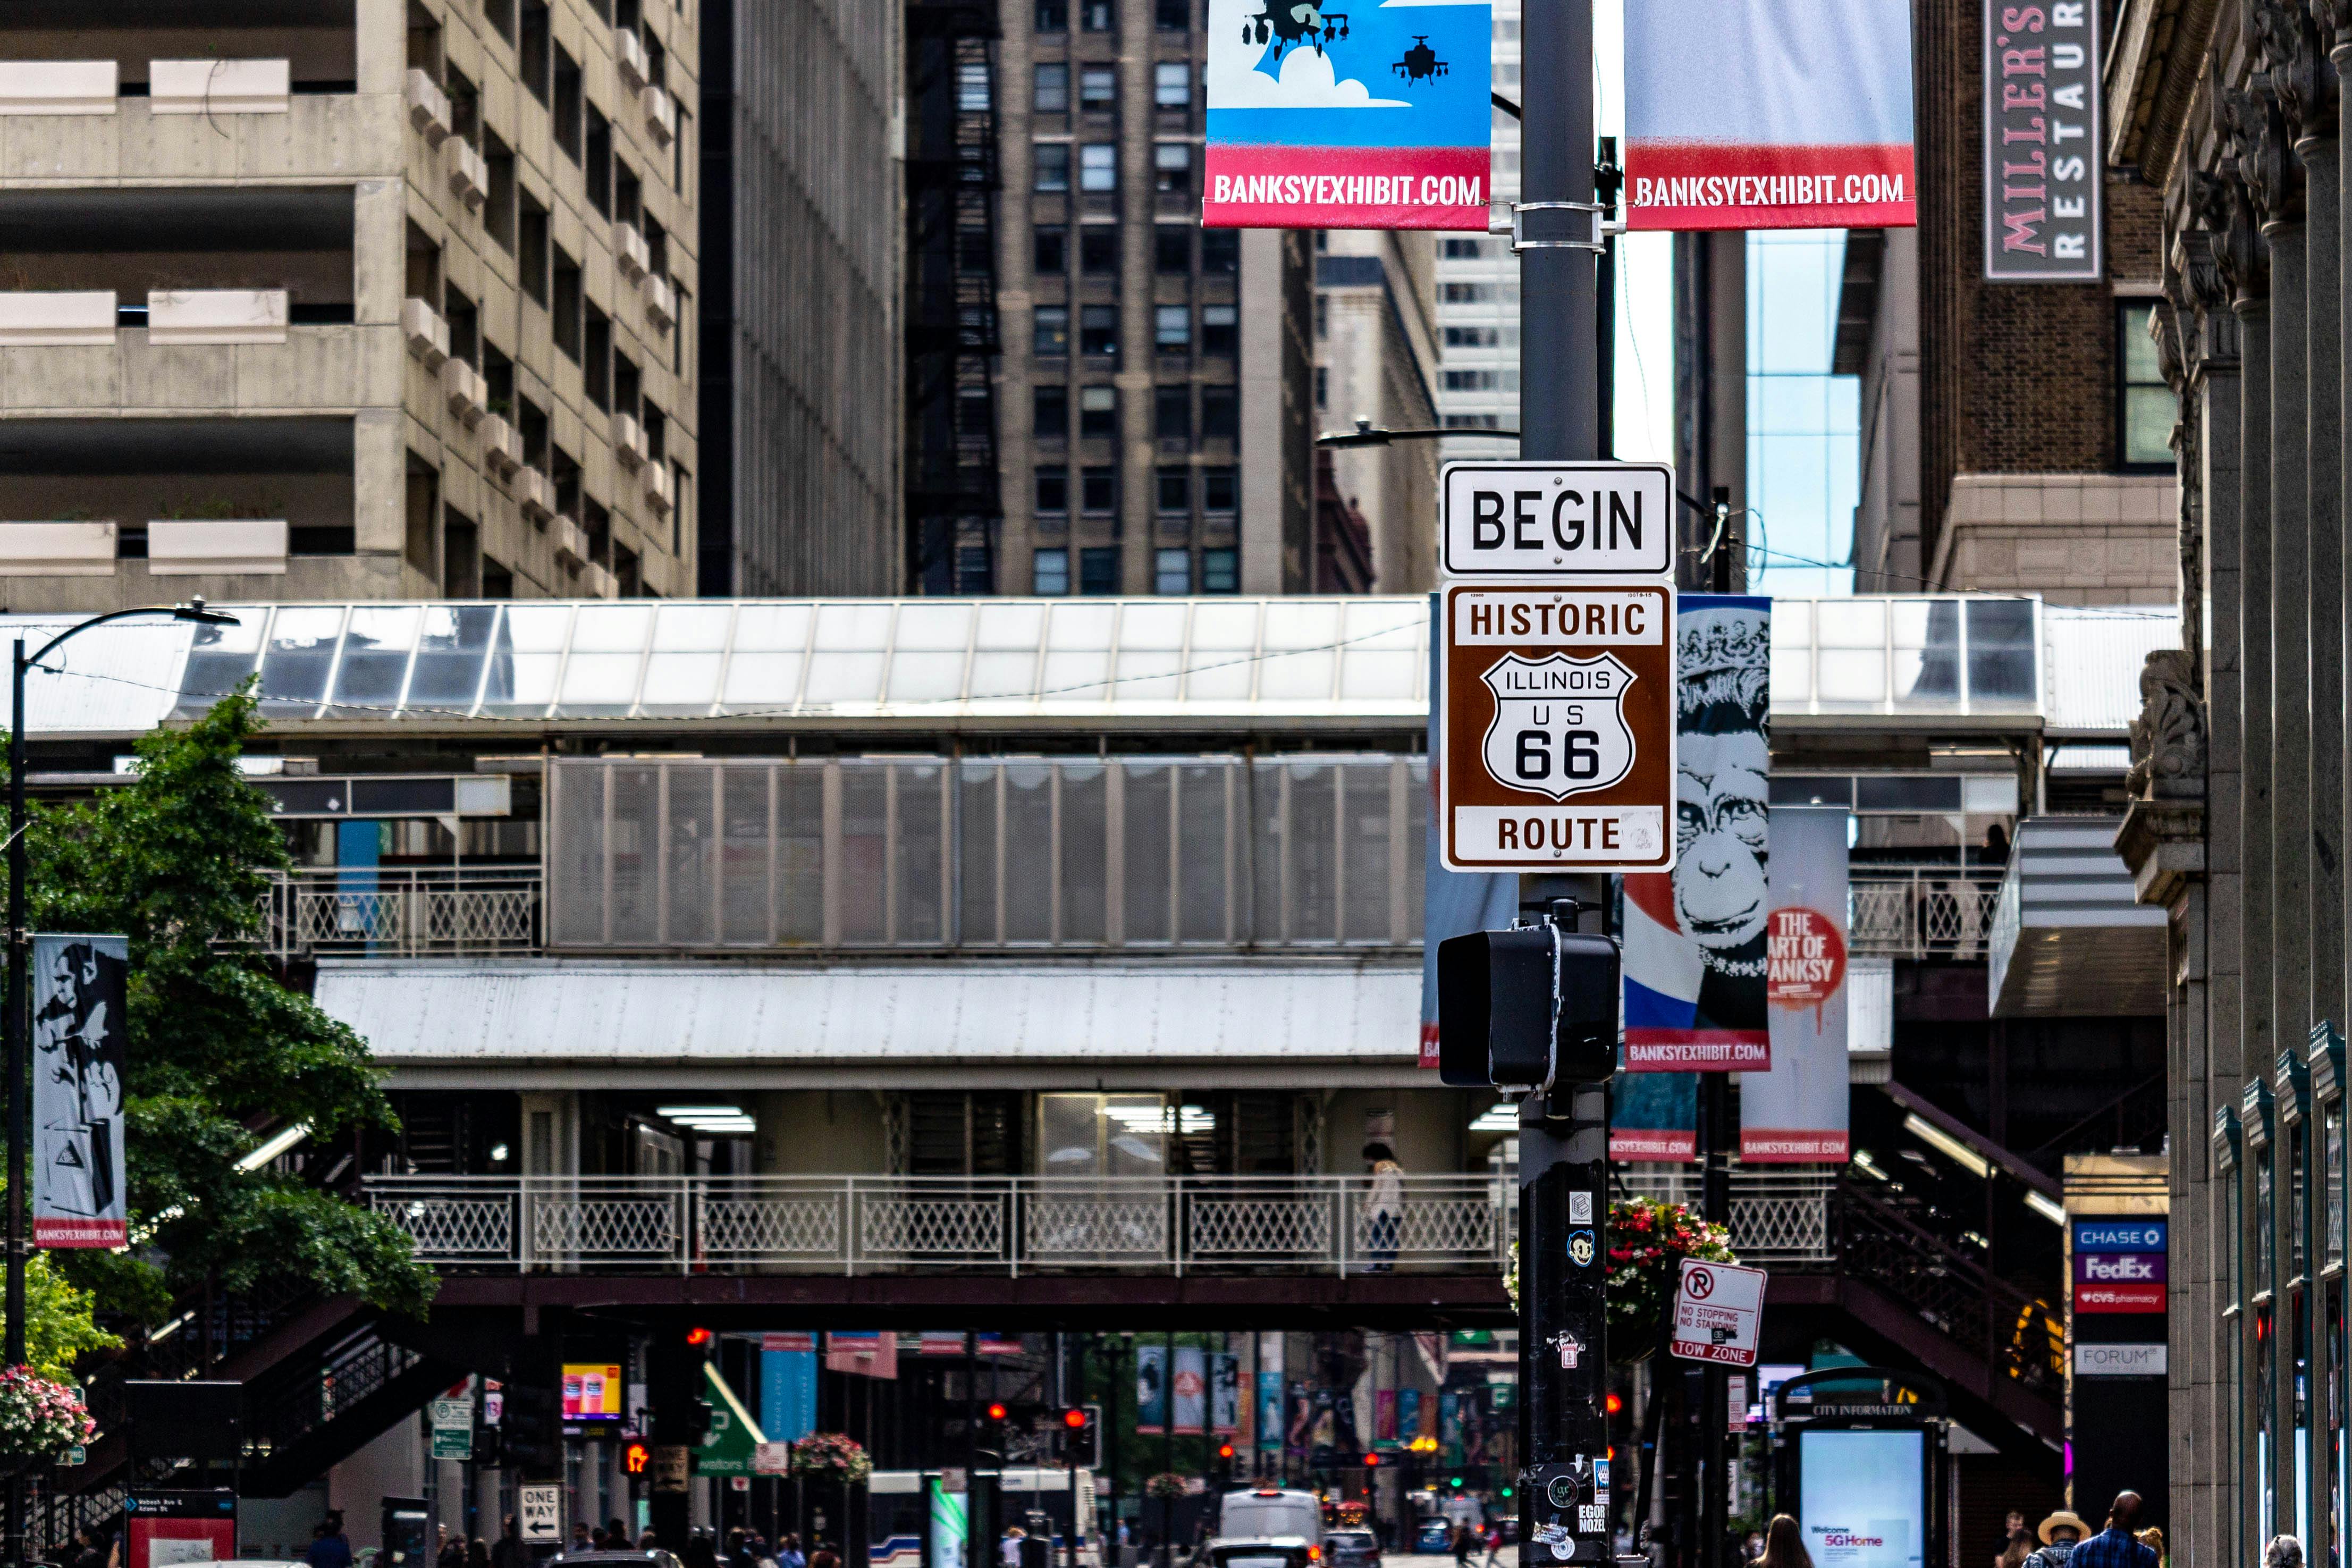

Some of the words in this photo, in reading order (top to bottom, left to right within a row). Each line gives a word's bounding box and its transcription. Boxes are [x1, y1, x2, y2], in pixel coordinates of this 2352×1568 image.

[1997, 6, 2046, 257] MILLER'S
[1214, 175, 1481, 206] BANKSYEXHIBIT.COM
[1637, 174, 1904, 208] BANKSYEXHIBIT.COM
[1473, 490, 1642, 551] BEGIN
[1470, 603, 1645, 635] HISTORIC
[1506, 671, 1610, 689] ILLINOIS
[1516, 730, 1600, 780] 66
[1498, 818, 1620, 850] ROUTE
[1778, 913, 1811, 935] THE
[1768, 936, 1799, 958] ART
[1802, 936, 1827, 958] OF
[1769, 958, 1834, 982] ANKSY
[1630, 1045, 1766, 1061] BANKSYEXHIBIT.COM
[1610, 1141, 1692, 1155] KSYEXHIBIT.COM
[1744, 1142, 1845, 1155] BANKSYEXHIBIT.COM
[36, 1229, 124, 1241] BANKSYEXHIBIT.COM
[2081, 1232, 2140, 1244] CHASE
[2086, 1256, 2153, 1279] FedEx
[2092, 1292, 2114, 1303] CVS
[2115, 1294, 2159, 1304] pharmacy
[1681, 1306, 1693, 1316] NO
[1697, 1308, 1738, 1322] STOPPING
[1680, 1317, 1692, 1327] NO
[1696, 1319, 1738, 1334] STANDING
[1677, 1342, 1706, 1356] TOW
[1712, 1347, 1747, 1362] ZONE
[2084, 1350, 2148, 1364] FORUM
[1813, 1405, 1836, 1415] CITY
[1840, 1405, 1912, 1415] INFORMATION
[525, 1490, 554, 1504] ONE
[525, 1506, 556, 1518] WAY
[1579, 1505, 1605, 1519] EGOR
[1579, 1519, 1606, 1533] NOZEL
[1825, 1535, 1843, 1546] 5G
[1845, 1535, 1883, 1546] Home
